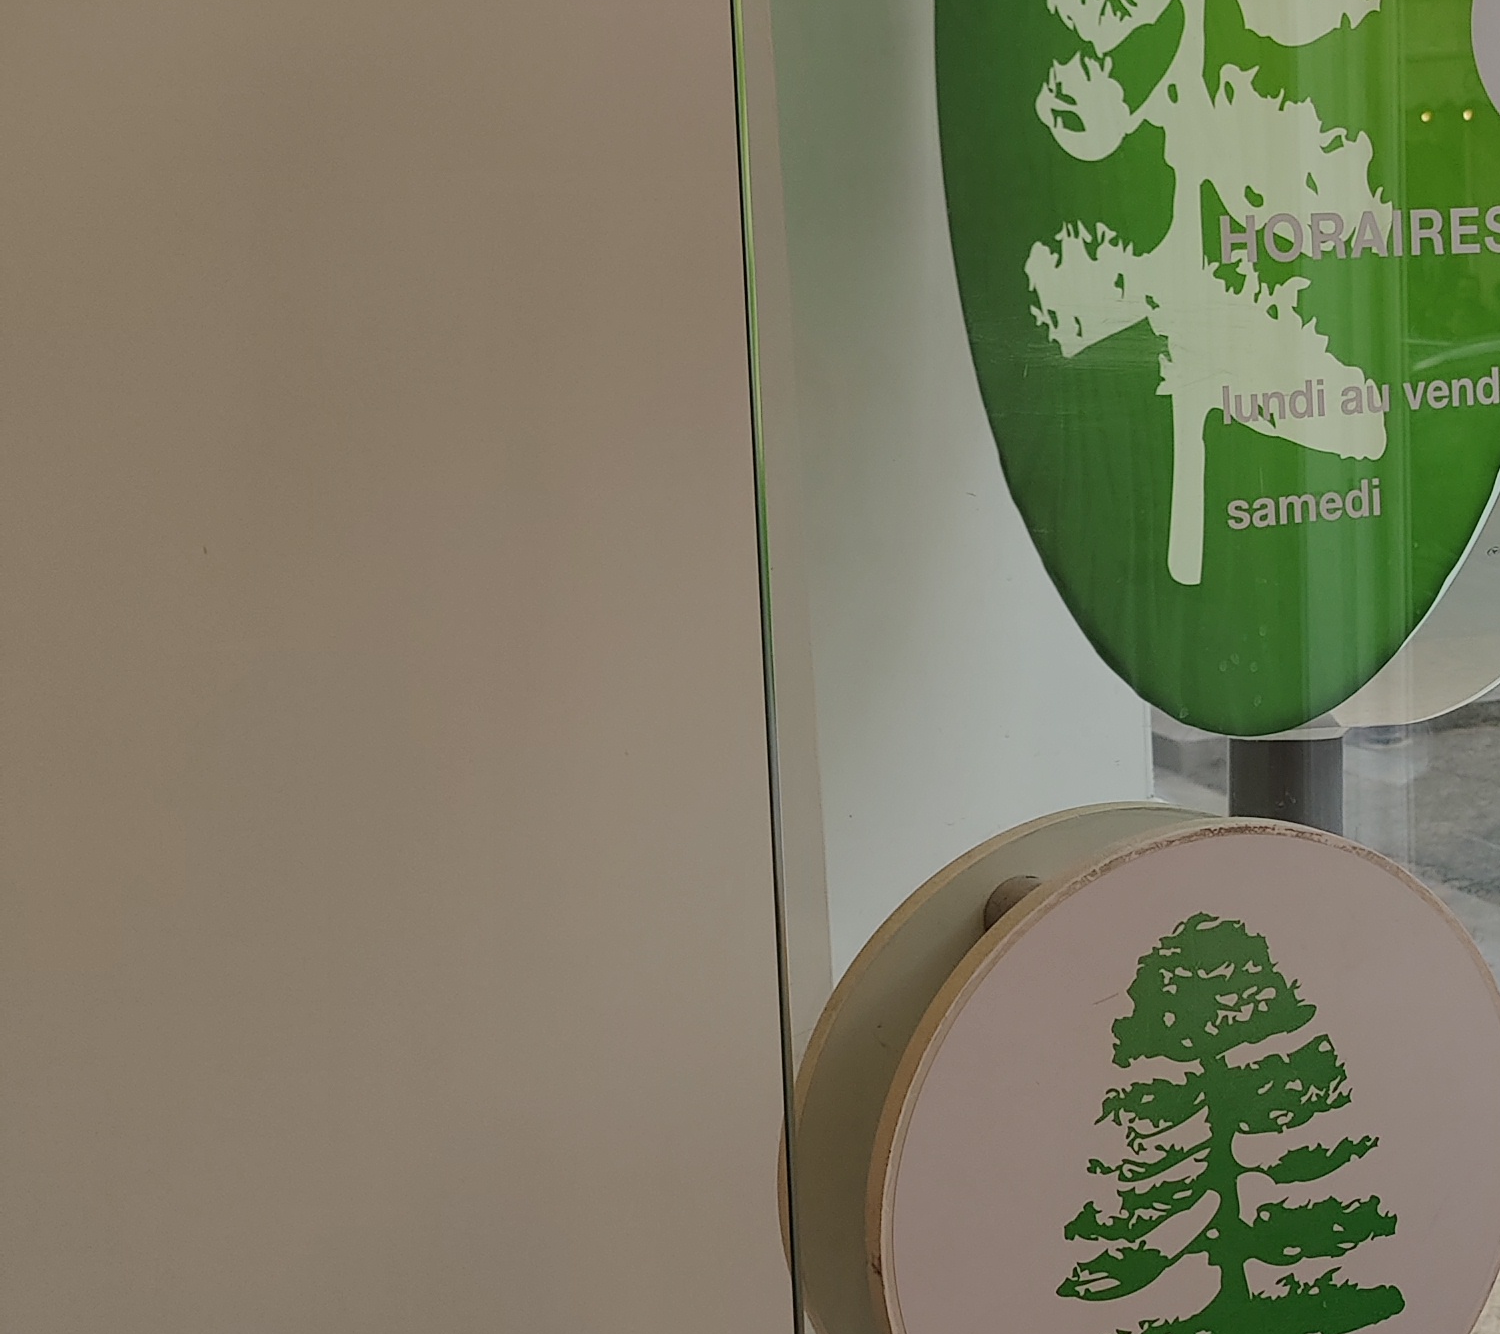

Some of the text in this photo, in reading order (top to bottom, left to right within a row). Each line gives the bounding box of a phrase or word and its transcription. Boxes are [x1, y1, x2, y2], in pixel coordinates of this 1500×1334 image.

[1221, 378, 1326, 425] lundi
[1340, 383, 1391, 416] au
[1226, 477, 1383, 531] samedi
